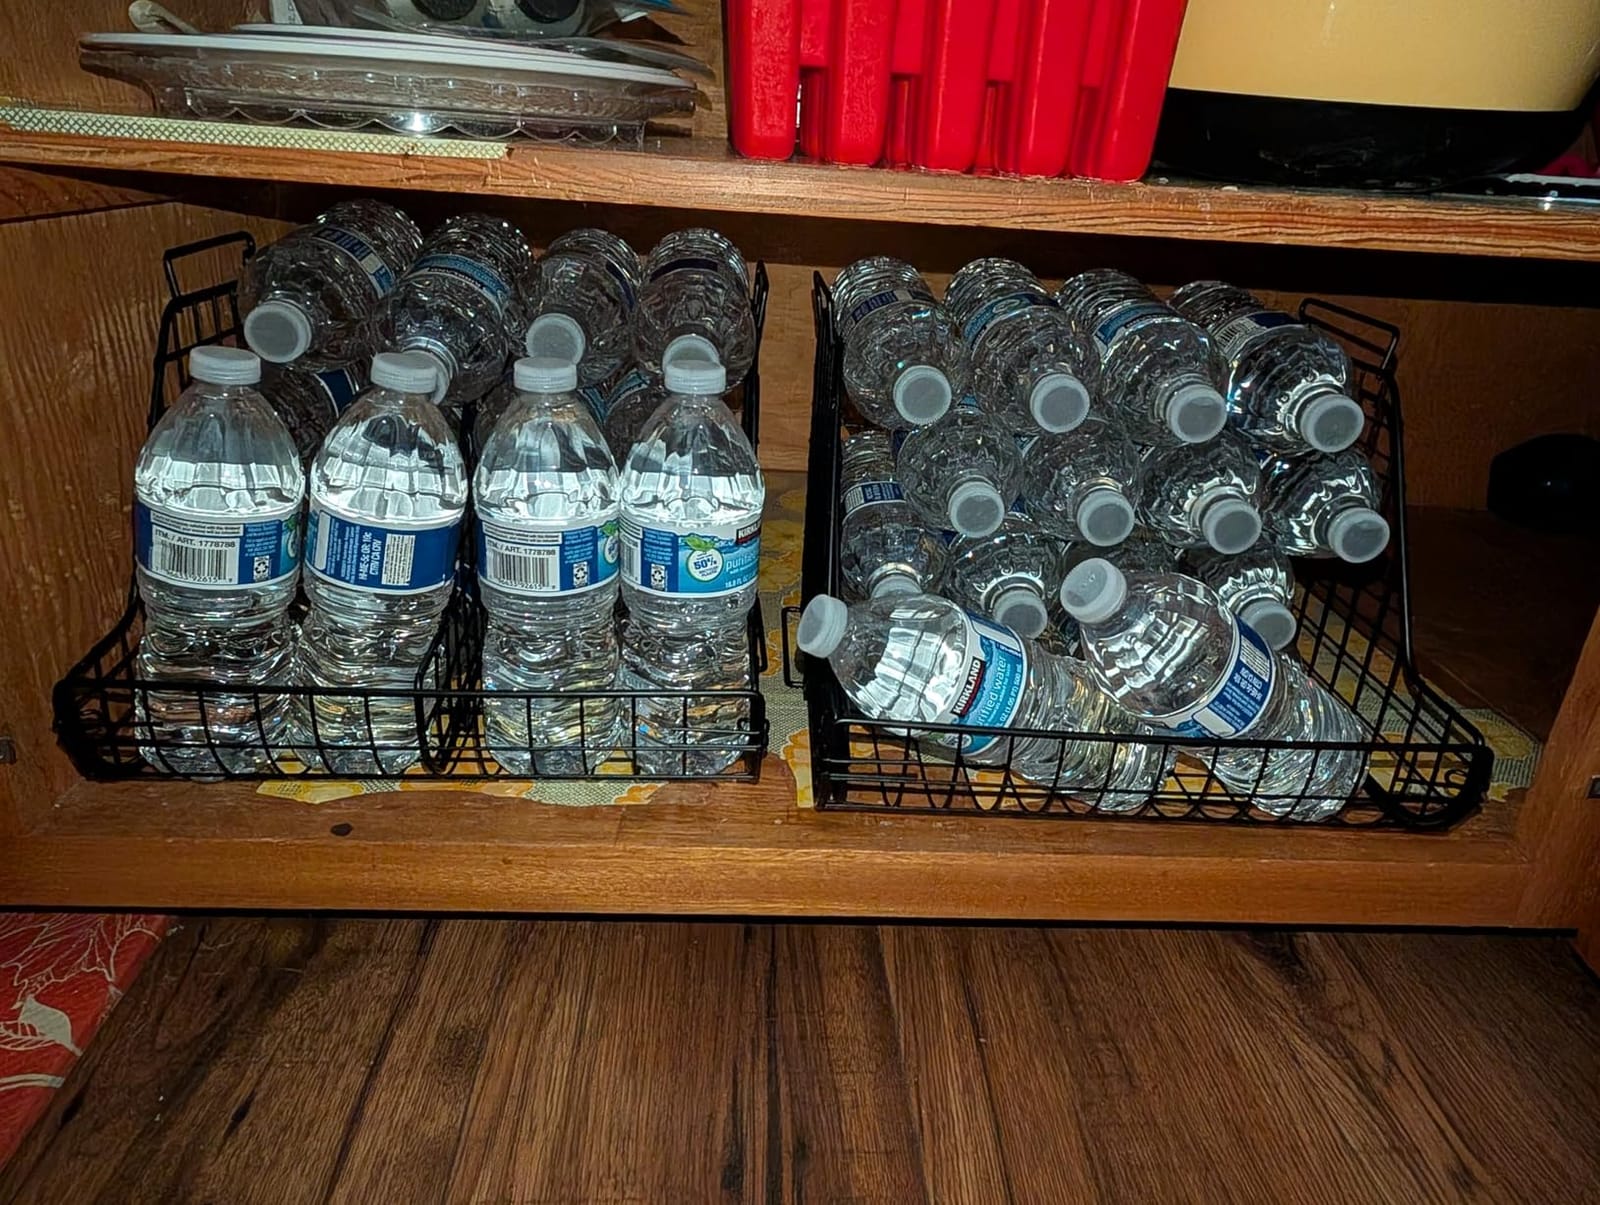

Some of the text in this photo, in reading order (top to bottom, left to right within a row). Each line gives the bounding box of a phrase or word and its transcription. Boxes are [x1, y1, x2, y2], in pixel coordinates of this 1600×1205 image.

[693, 556, 717, 571] 50%
[953, 659, 981, 714] KIRKLAND
[976, 656, 1007, 726] urified water
